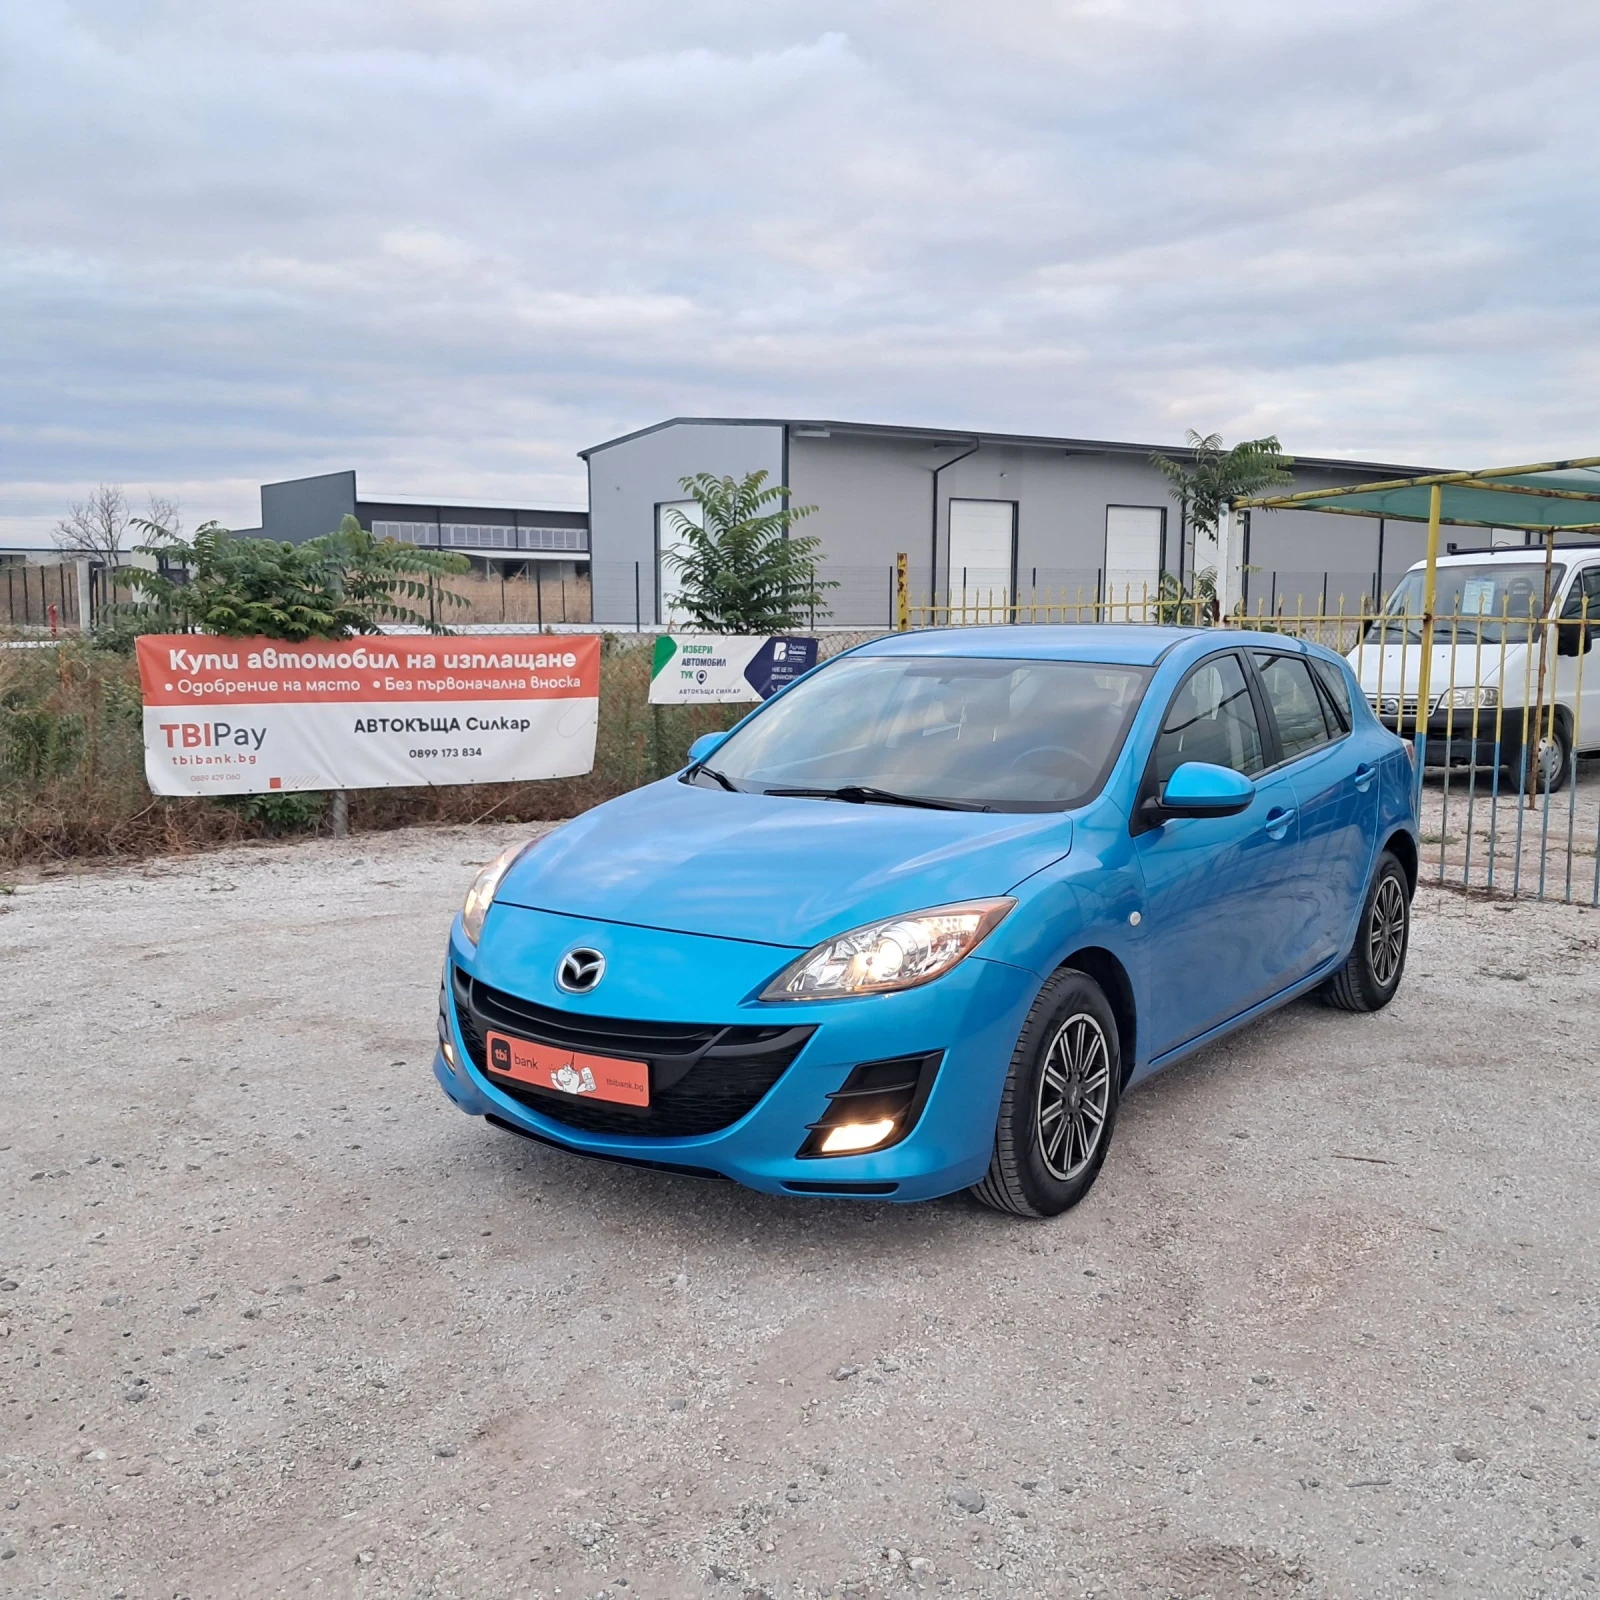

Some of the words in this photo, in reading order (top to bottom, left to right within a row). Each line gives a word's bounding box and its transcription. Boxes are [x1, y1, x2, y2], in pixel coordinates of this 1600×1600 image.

[682, 646, 713, 655] ИЗБЕРИ
[169, 649, 239, 675] Купи
[247, 647, 399, 669] автомобил
[406, 653, 436, 669] на
[443, 651, 577, 670] изплащане
[682, 658, 727, 667] АВТОМОБИЛ
[680, 671, 694, 680] ТУК
[177, 678, 279, 697] Одобрение
[282, 681, 302, 693] на
[305, 680, 361, 692] място
[384, 676, 413, 691] Без
[417, 676, 527, 693] първоначална
[530, 675, 581, 690] вноска
[678, 688, 714, 696] АВТОКЪЩА
[354, 717, 461, 734] АВТОКЪЩА
[466, 716, 531, 733] Силкар
[159, 722, 267, 751] TBIPay
[172, 753, 257, 766] tbibank.bg
[408, 749, 438, 759] 0899
[441, 748, 459, 758] 173
[462, 747, 482, 757] 834
[211, 773, 225, 782] 429
[225, 772, 241, 781] 060
[495, 1048, 508, 1062] tbi
[514, 1053, 539, 1070] bank
[606, 1077, 645, 1093] tbibank.bg
